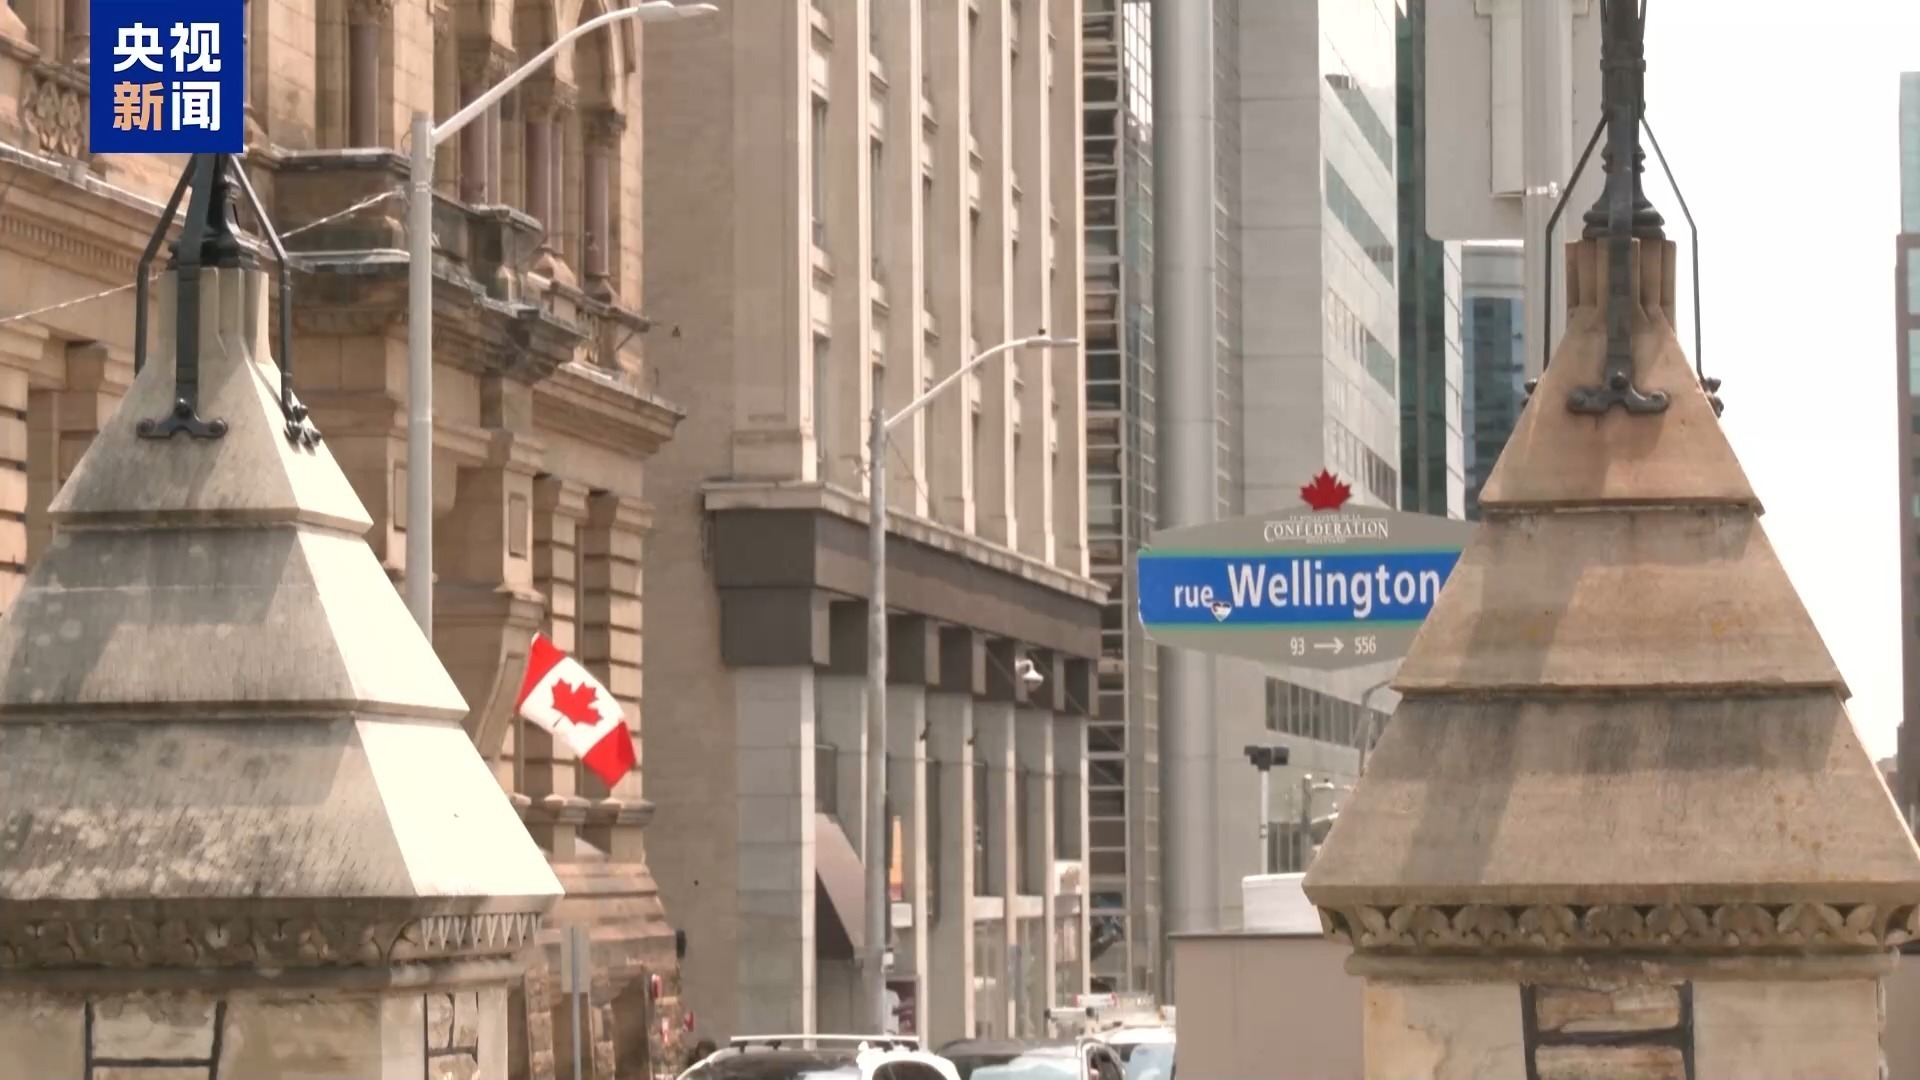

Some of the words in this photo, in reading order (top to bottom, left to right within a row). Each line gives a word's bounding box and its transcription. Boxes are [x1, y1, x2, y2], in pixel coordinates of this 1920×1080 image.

[1264, 519, 1388, 543] CONFEDERATION
[1174, 585, 1213, 608] rue
[1227, 560, 1440, 618] Wellington
[1290, 638, 1305, 656] 93
[1354, 636, 1376, 655] 556
